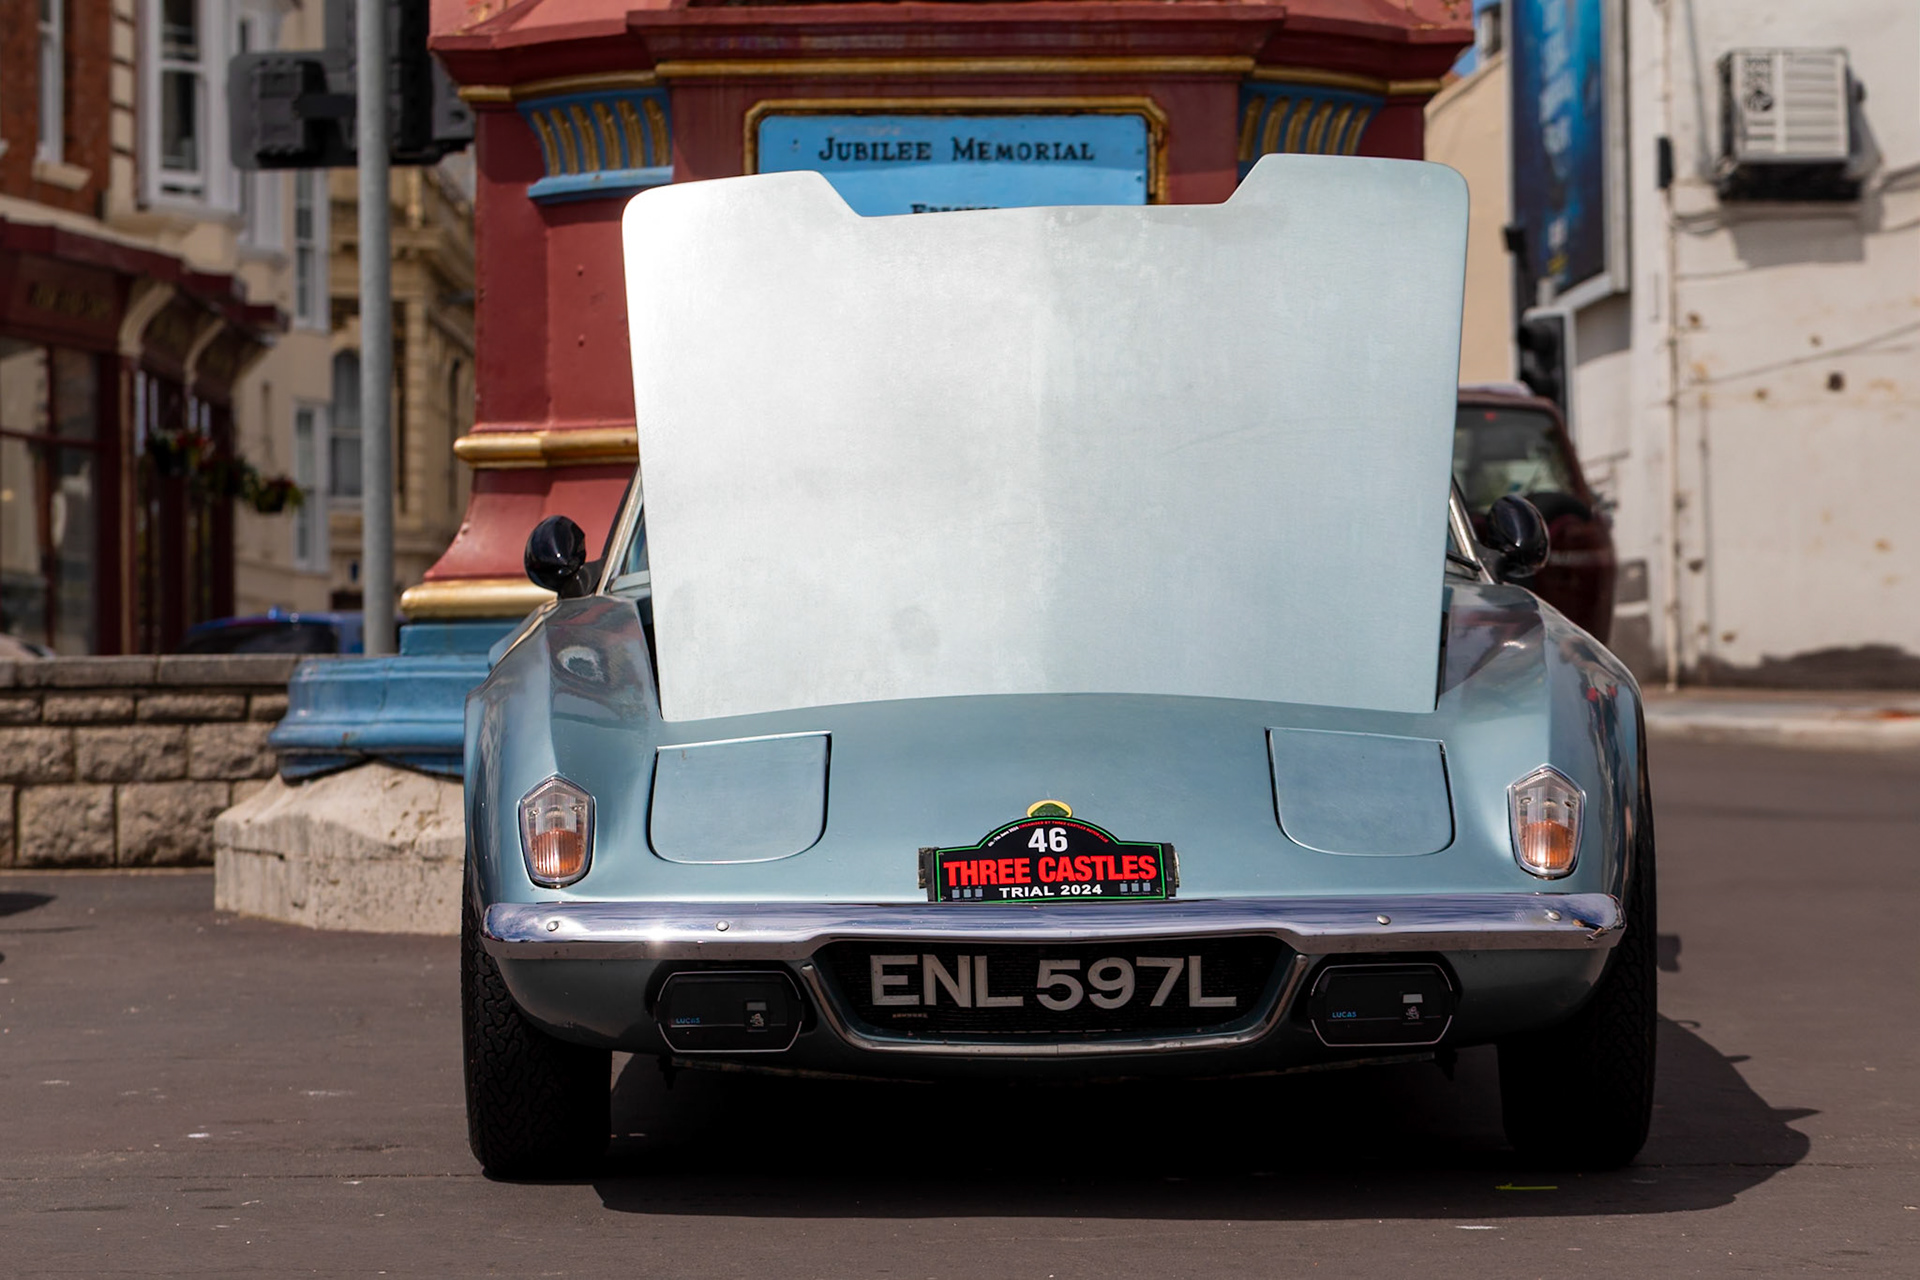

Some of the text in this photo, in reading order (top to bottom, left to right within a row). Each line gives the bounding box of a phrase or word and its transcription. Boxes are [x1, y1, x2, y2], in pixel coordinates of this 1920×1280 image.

[818, 137, 1095, 162] JUBILEE MEMORIAL
[1028, 827, 1068, 853] 46
[943, 855, 1157, 887] THREE CASTLES
[999, 883, 1103, 899] TRIAL 2024
[870, 954, 1237, 1011] ENL 597L
